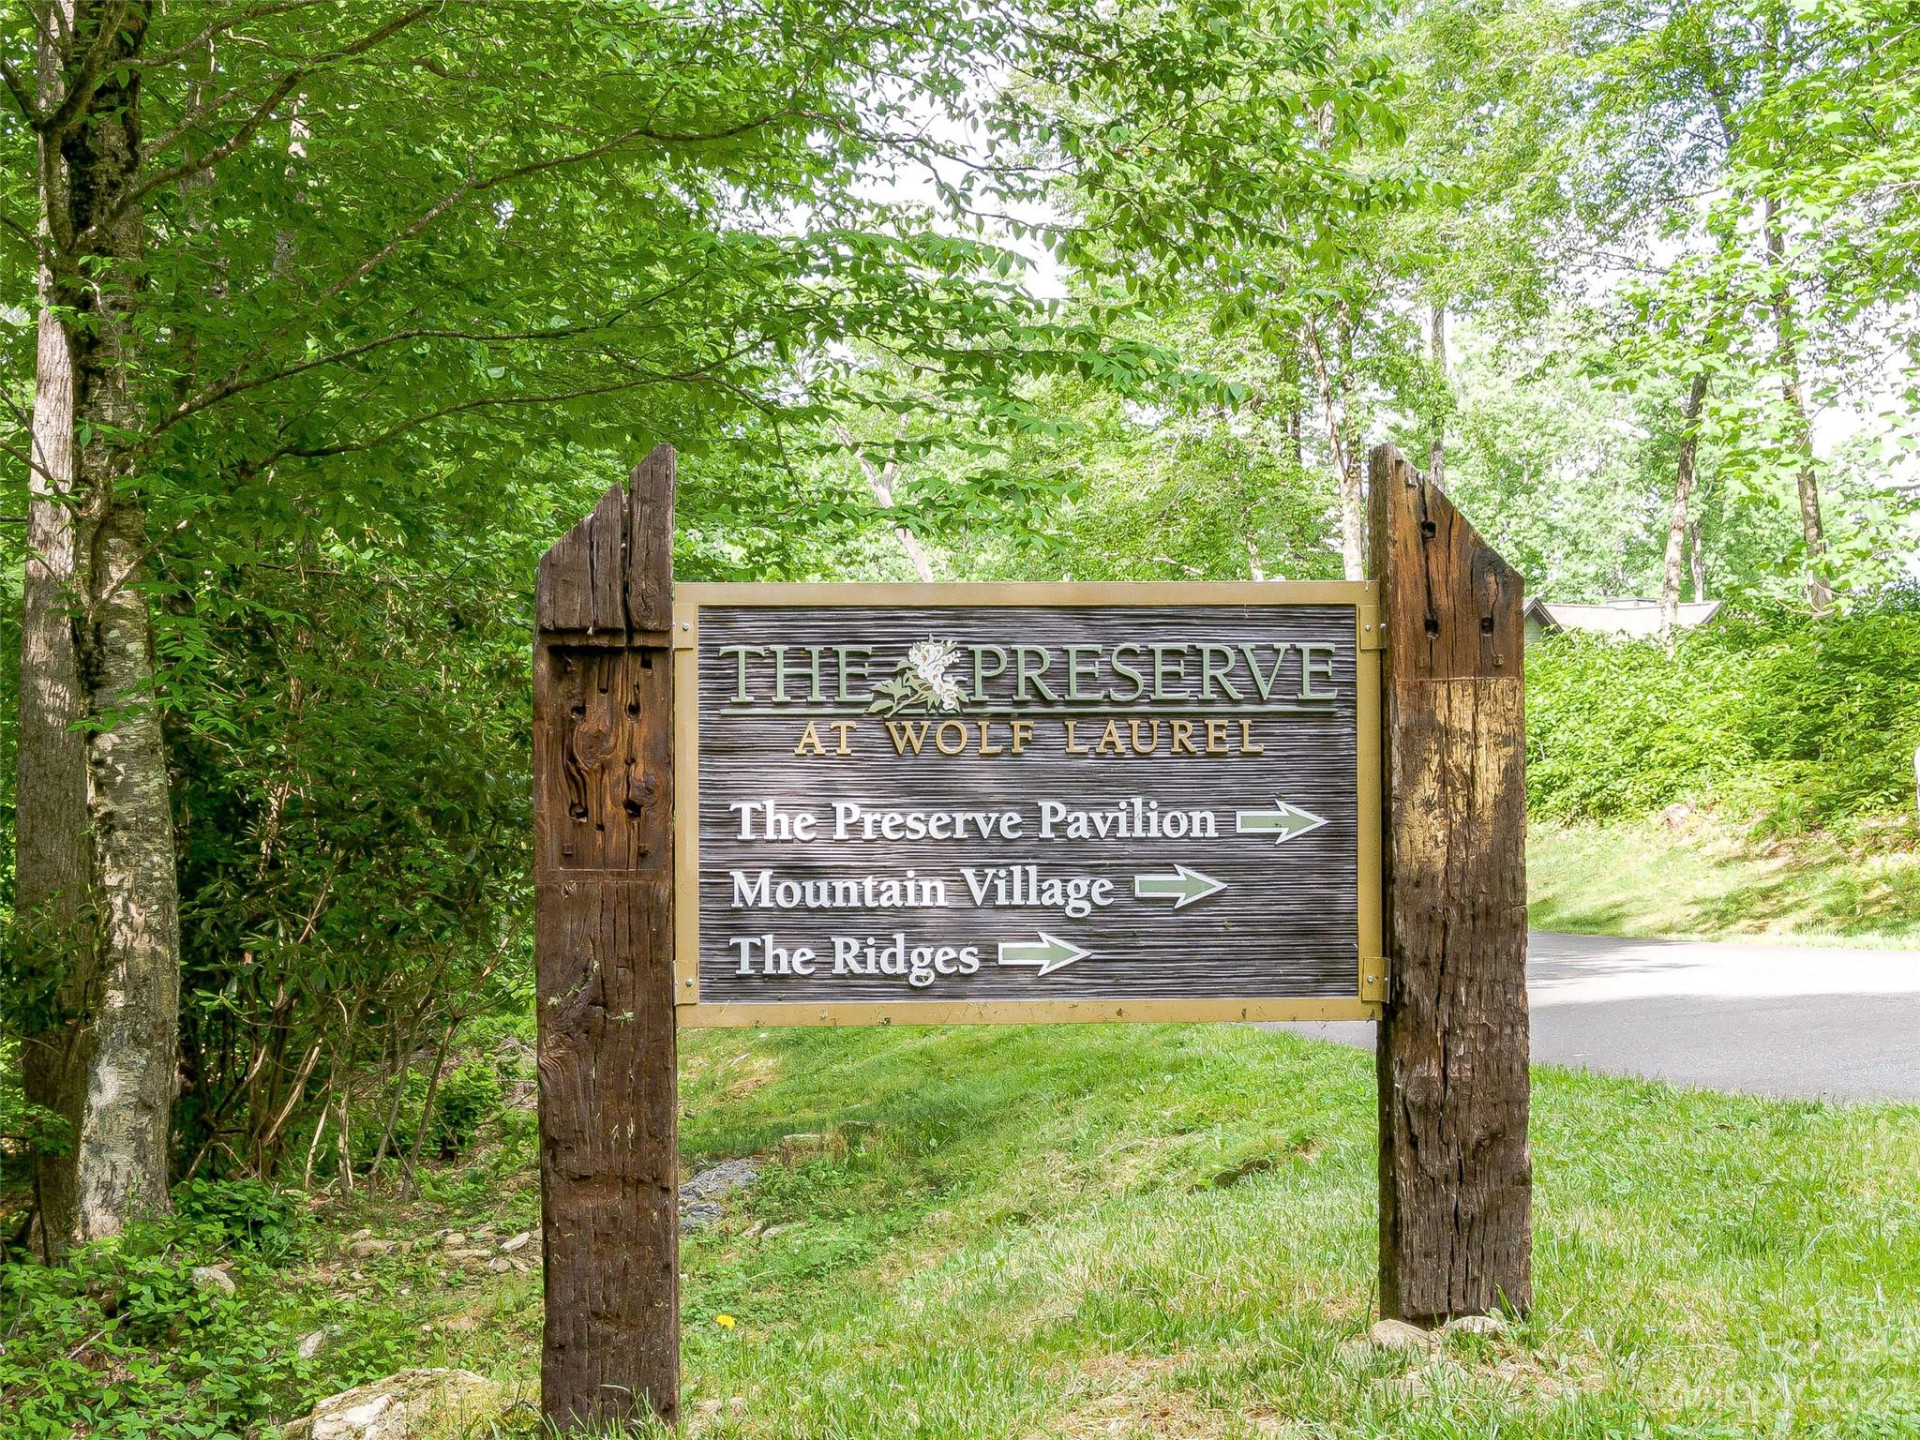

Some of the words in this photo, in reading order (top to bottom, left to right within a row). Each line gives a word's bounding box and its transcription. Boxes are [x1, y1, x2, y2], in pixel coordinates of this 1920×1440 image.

[719, 644, 875, 703] THE
[967, 642, 1339, 701] PRESERVE
[794, 719, 858, 756] AT
[883, 718, 1036, 756] WOLF
[1064, 718, 1266, 755] LAUREL
[729, 800, 818, 843] The
[830, 801, 1023, 842] Preserve
[1037, 797, 1220, 841] Pavilion
[730, 868, 948, 910] Mountain
[960, 864, 1115, 918] Village
[729, 935, 817, 977] The
[830, 932, 981, 988] Ridges
